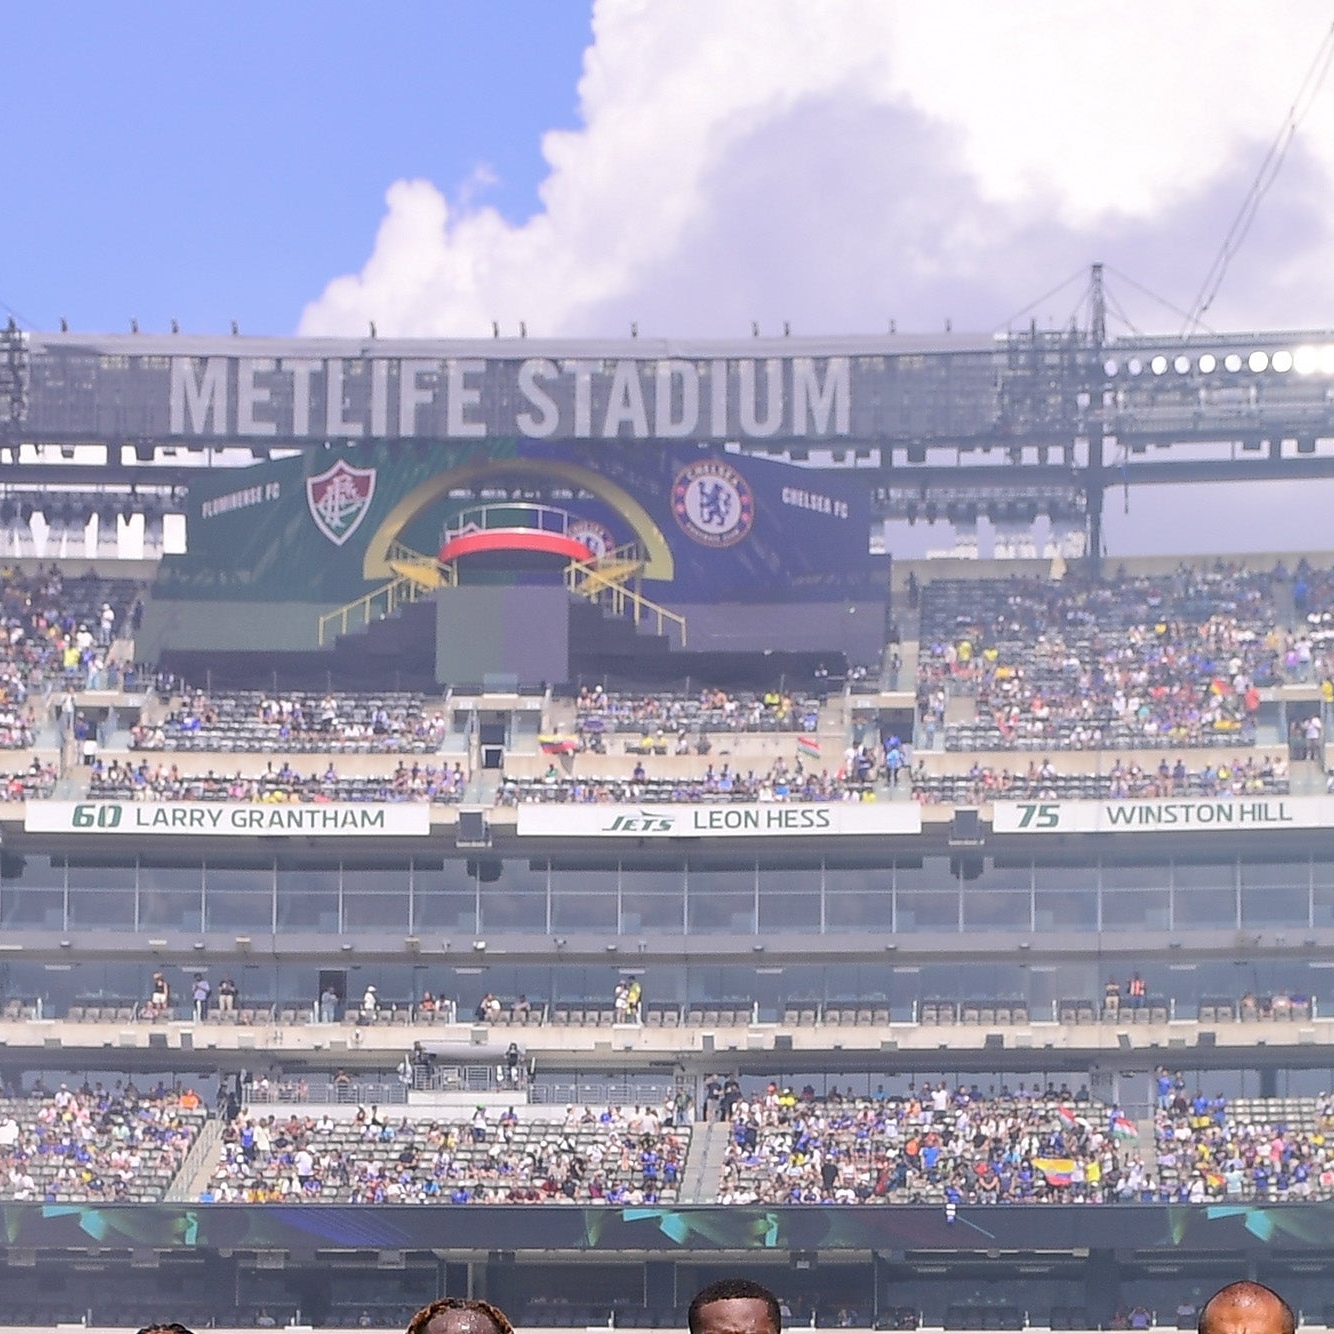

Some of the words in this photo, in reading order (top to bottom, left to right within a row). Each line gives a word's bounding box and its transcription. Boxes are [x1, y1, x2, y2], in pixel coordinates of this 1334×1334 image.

[171, 359, 487, 438] METLIFE
[517, 357, 852, 439] STADIUM
[781, 486, 832, 514] CHELSEA
[834, 501, 849, 519] FC
[72, 804, 123, 828] 60
[136, 807, 223, 828] LARRY
[232, 808, 385, 829] GRANTHAM
[602, 810, 675, 832] JETS
[693, 809, 759, 830] LEON
[767, 808, 831, 828] HESS
[1016, 804, 1061, 828] 75
[1107, 804, 1233, 825] WINSTON
[1240, 802, 1293, 823] HILL
